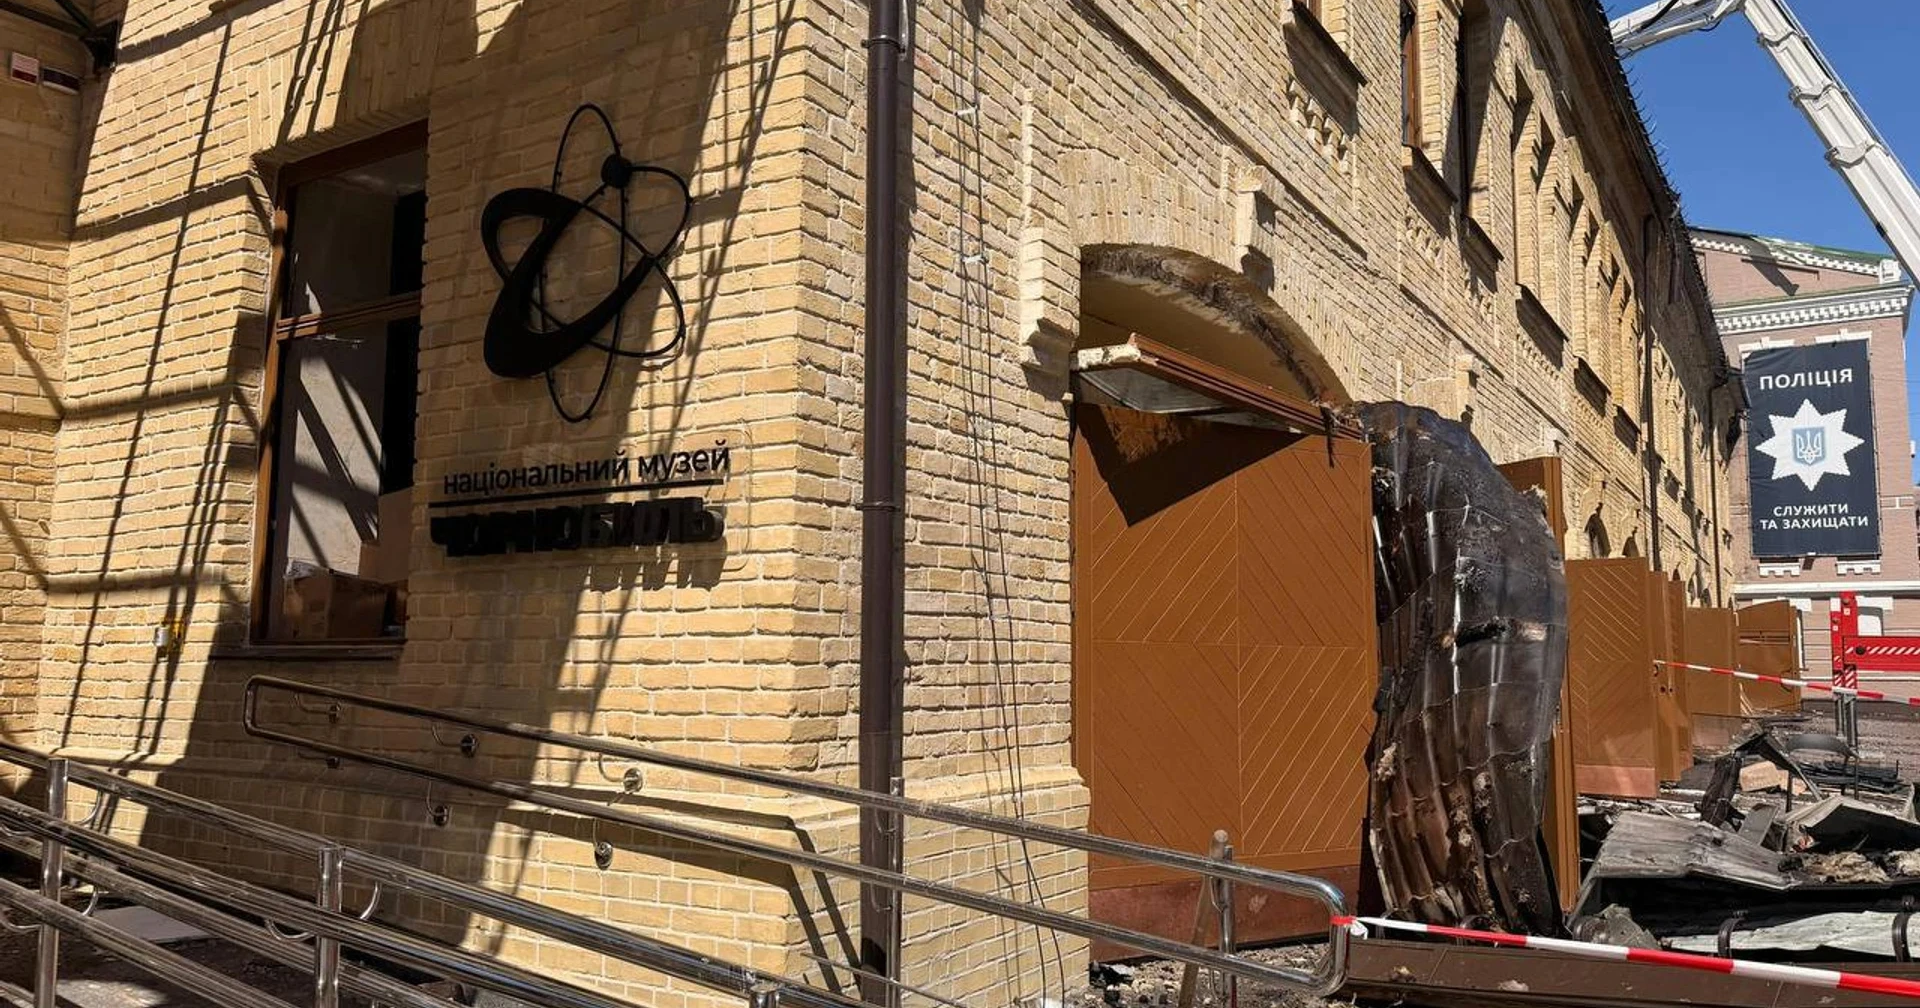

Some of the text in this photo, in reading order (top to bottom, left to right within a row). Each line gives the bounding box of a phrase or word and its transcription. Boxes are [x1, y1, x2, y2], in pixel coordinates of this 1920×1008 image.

[1759, 368, 1853, 390] ПОЛІЦІЯ
[443, 439, 730, 496] національний музей
[1773, 503, 1849, 517] СЛУЖИТИ
[1759, 515, 1869, 530] ТА ЗАХИЩАТИ
